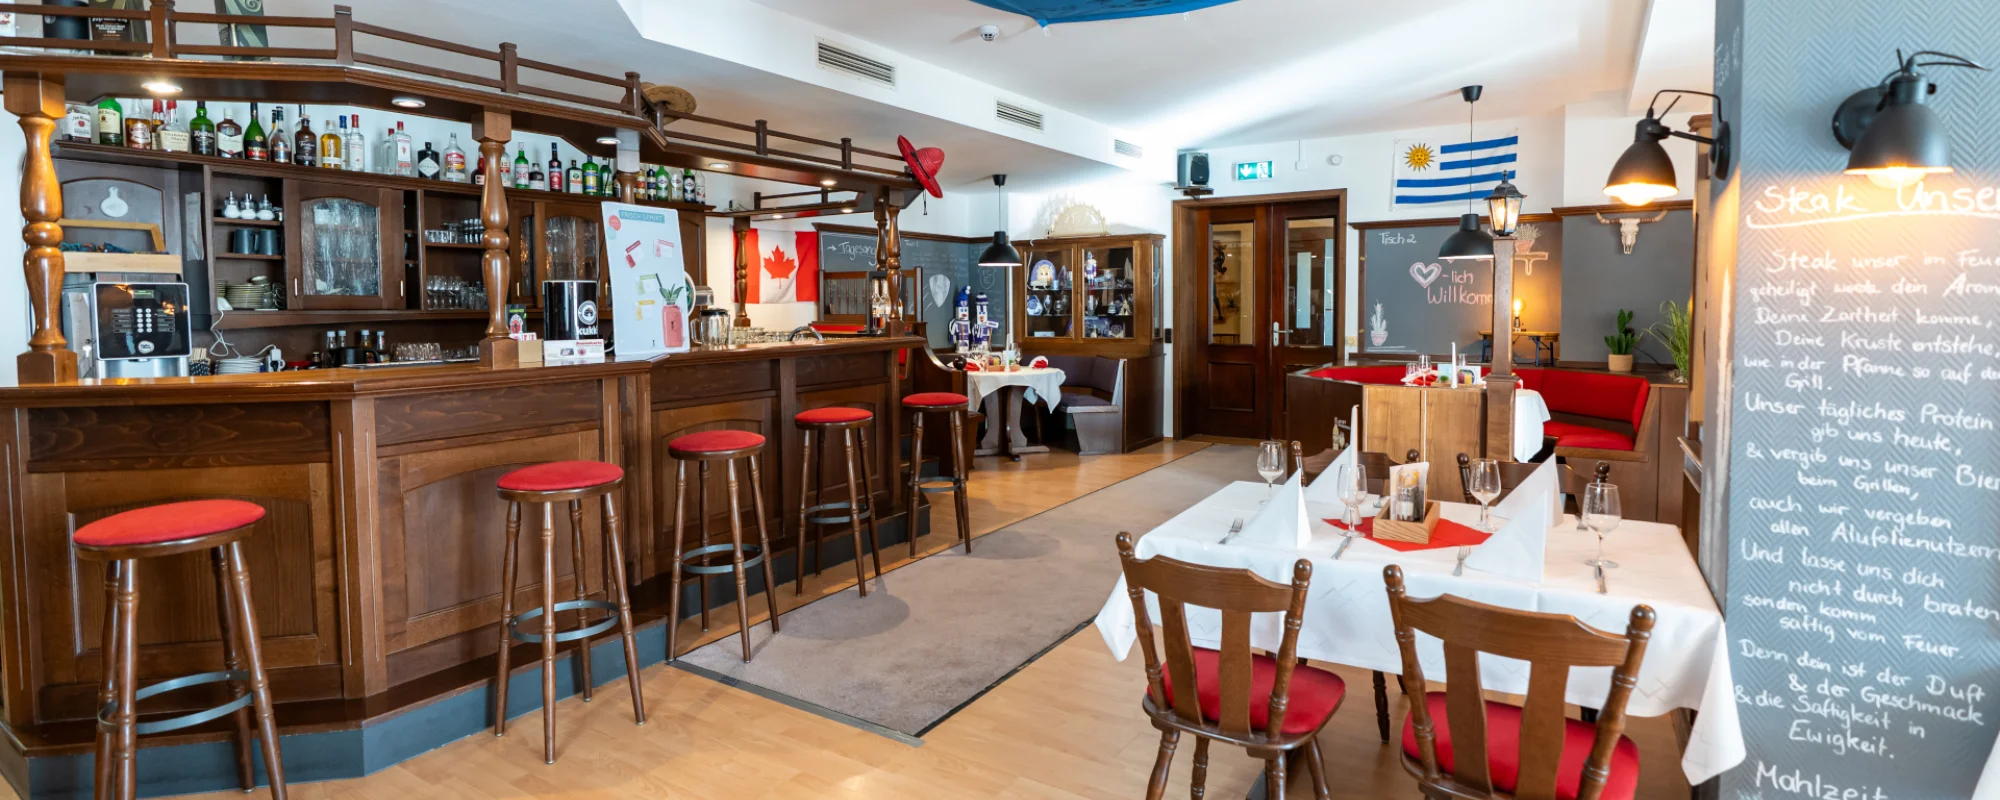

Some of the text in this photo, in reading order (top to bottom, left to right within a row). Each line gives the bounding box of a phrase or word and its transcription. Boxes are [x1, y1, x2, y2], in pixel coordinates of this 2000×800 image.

[1754, 184, 1868, 214] Steak
[1378, 231, 1417, 245] Tisch 2
[1766, 249, 1837, 273] Steak
[1852, 255, 1908, 268] unser
[1923, 252, 1946, 266] im
[1892, 277, 1928, 294] dein
[1819, 306, 1899, 323] Zartheit
[1915, 308, 1992, 329] komme,
[1775, 329, 1825, 347] Deine
[1840, 330, 1902, 351] Kruste
[1743, 353, 2000, 385] wie in der Pfanne so auf de
[1785, 372, 1832, 393] Grill.
[1744, 391, 1993, 430] Unser tägliches Protein
[1811, 426, 1961, 456] gib uns heute,
[1746, 442, 1764, 459] &
[1769, 448, 1828, 470] vergib
[1838, 455, 1872, 471] uns
[1884, 460, 1938, 479] unser
[1797, 470, 1838, 488] beim
[1749, 494, 1952, 534] auch wir vergeben
[1770, 519, 1810, 537] allen
[1740, 537, 1945, 590] Und lasse uns dich
[1788, 579, 2000, 621] nicht durch braten
[1819, 601, 1877, 625] komm
[1779, 614, 1835, 644] saftig
[1846, 626, 1886, 645] vom
[1738, 638, 1987, 702] Denn dein ist der Duft
[1734, 684, 1926, 739] & die Saftigkeit in
[1788, 673, 1985, 726] & der Geschmack
[1788, 719, 1895, 760] Ewigkeit.
[1755, 760, 1889, 800] Mahlzeit
